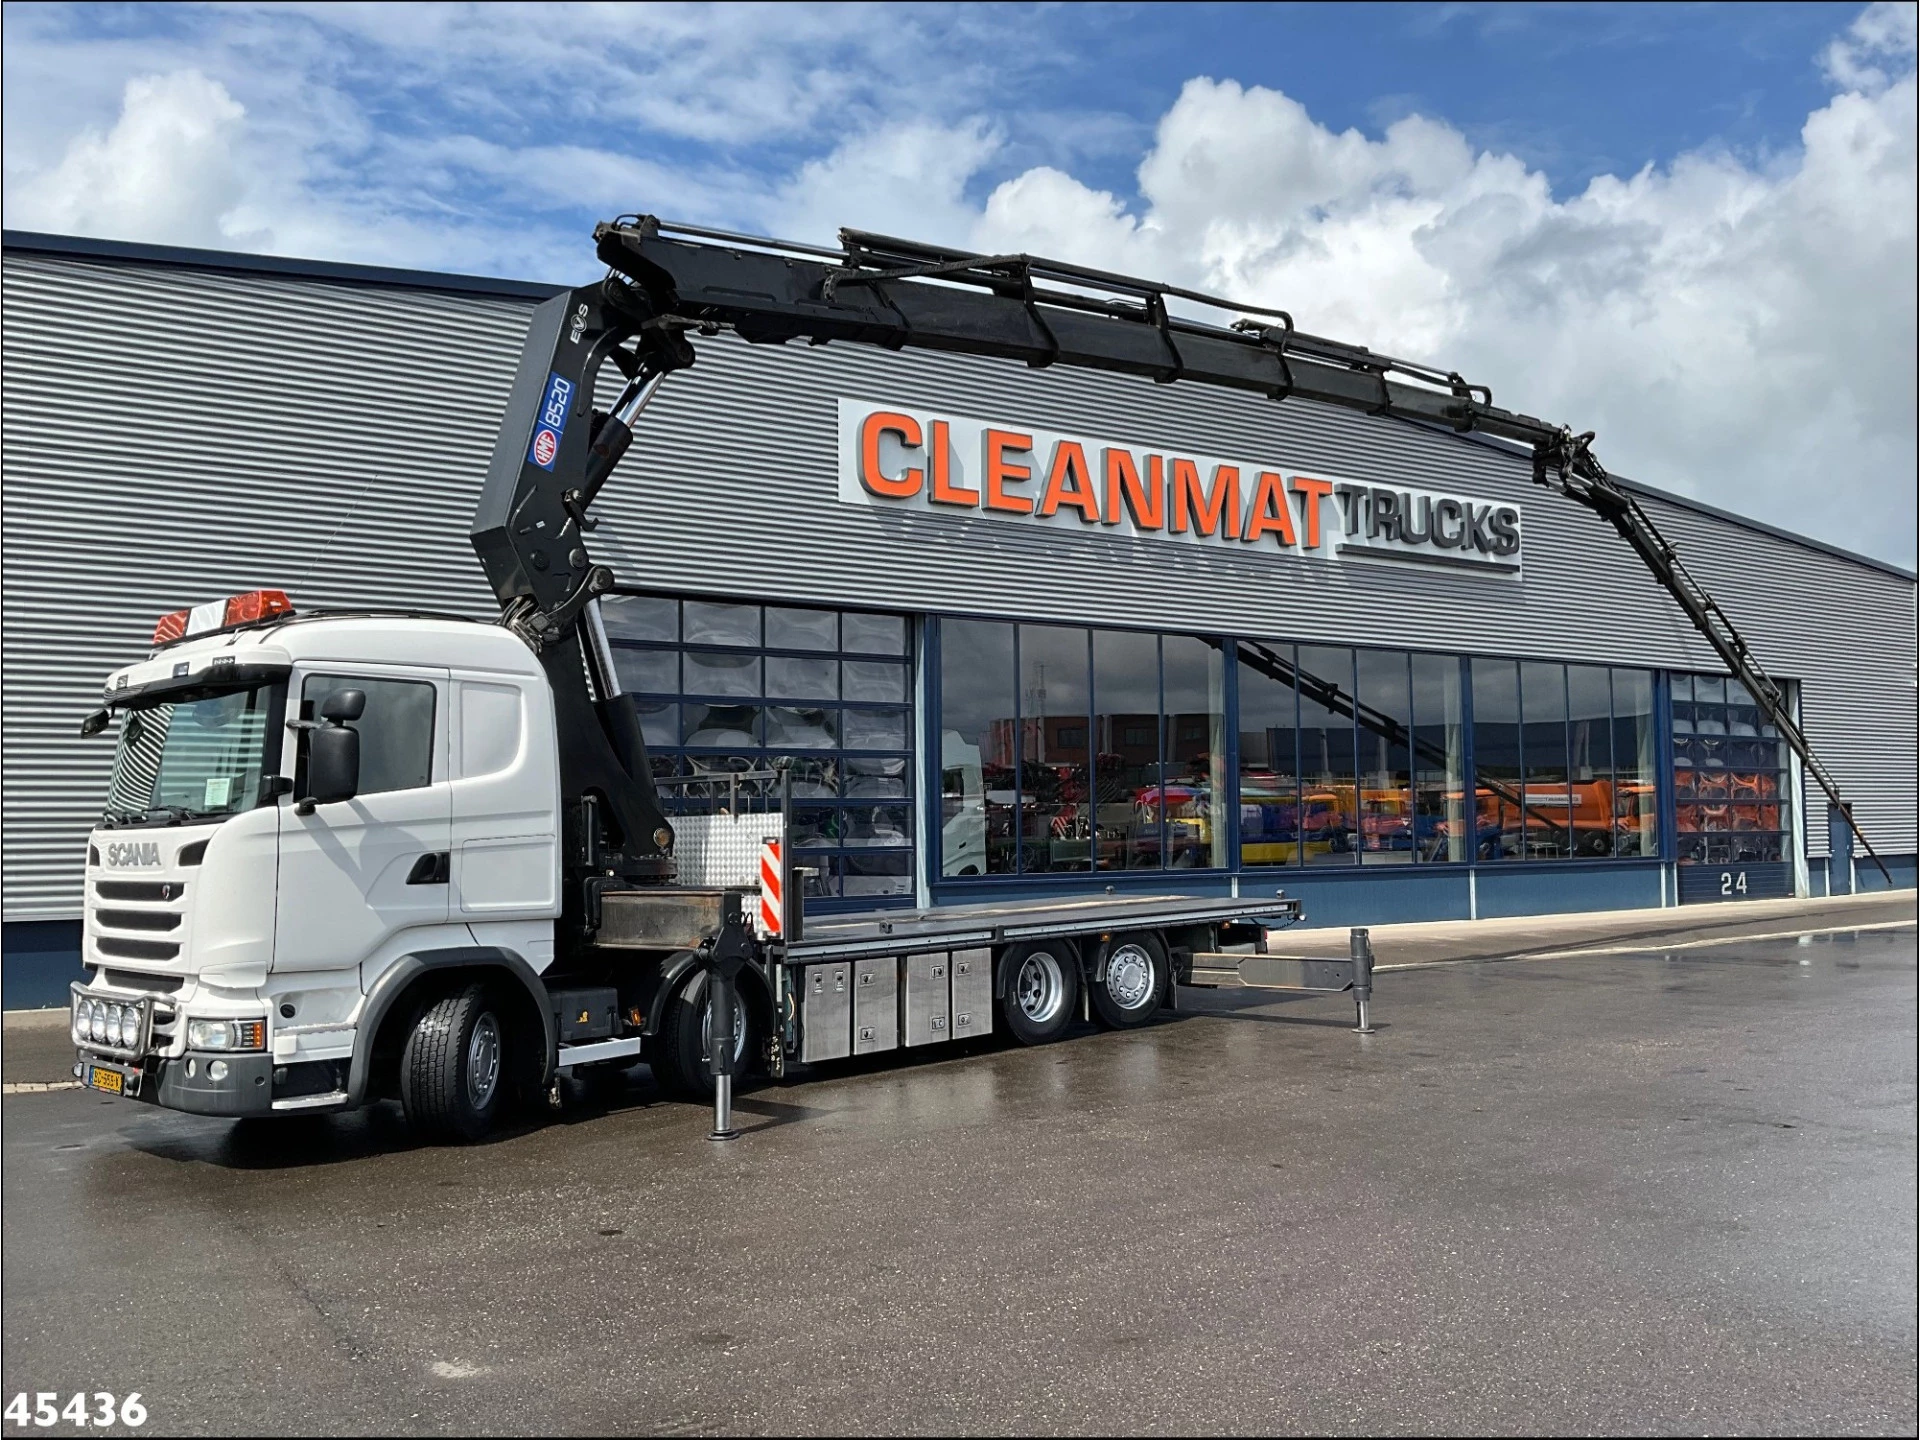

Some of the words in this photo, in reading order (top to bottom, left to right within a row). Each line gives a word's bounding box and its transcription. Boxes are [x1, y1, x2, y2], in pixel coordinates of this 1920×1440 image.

[570, 303, 588, 344] EVS
[545, 377, 570, 427] 8520
[537, 433, 555, 462] HMF
[861, 411, 1332, 549] CLEANMAT
[1334, 483, 1520, 556] TRUCKS
[108, 842, 161, 866] SCANIA
[1721, 871, 1747, 895] 24
